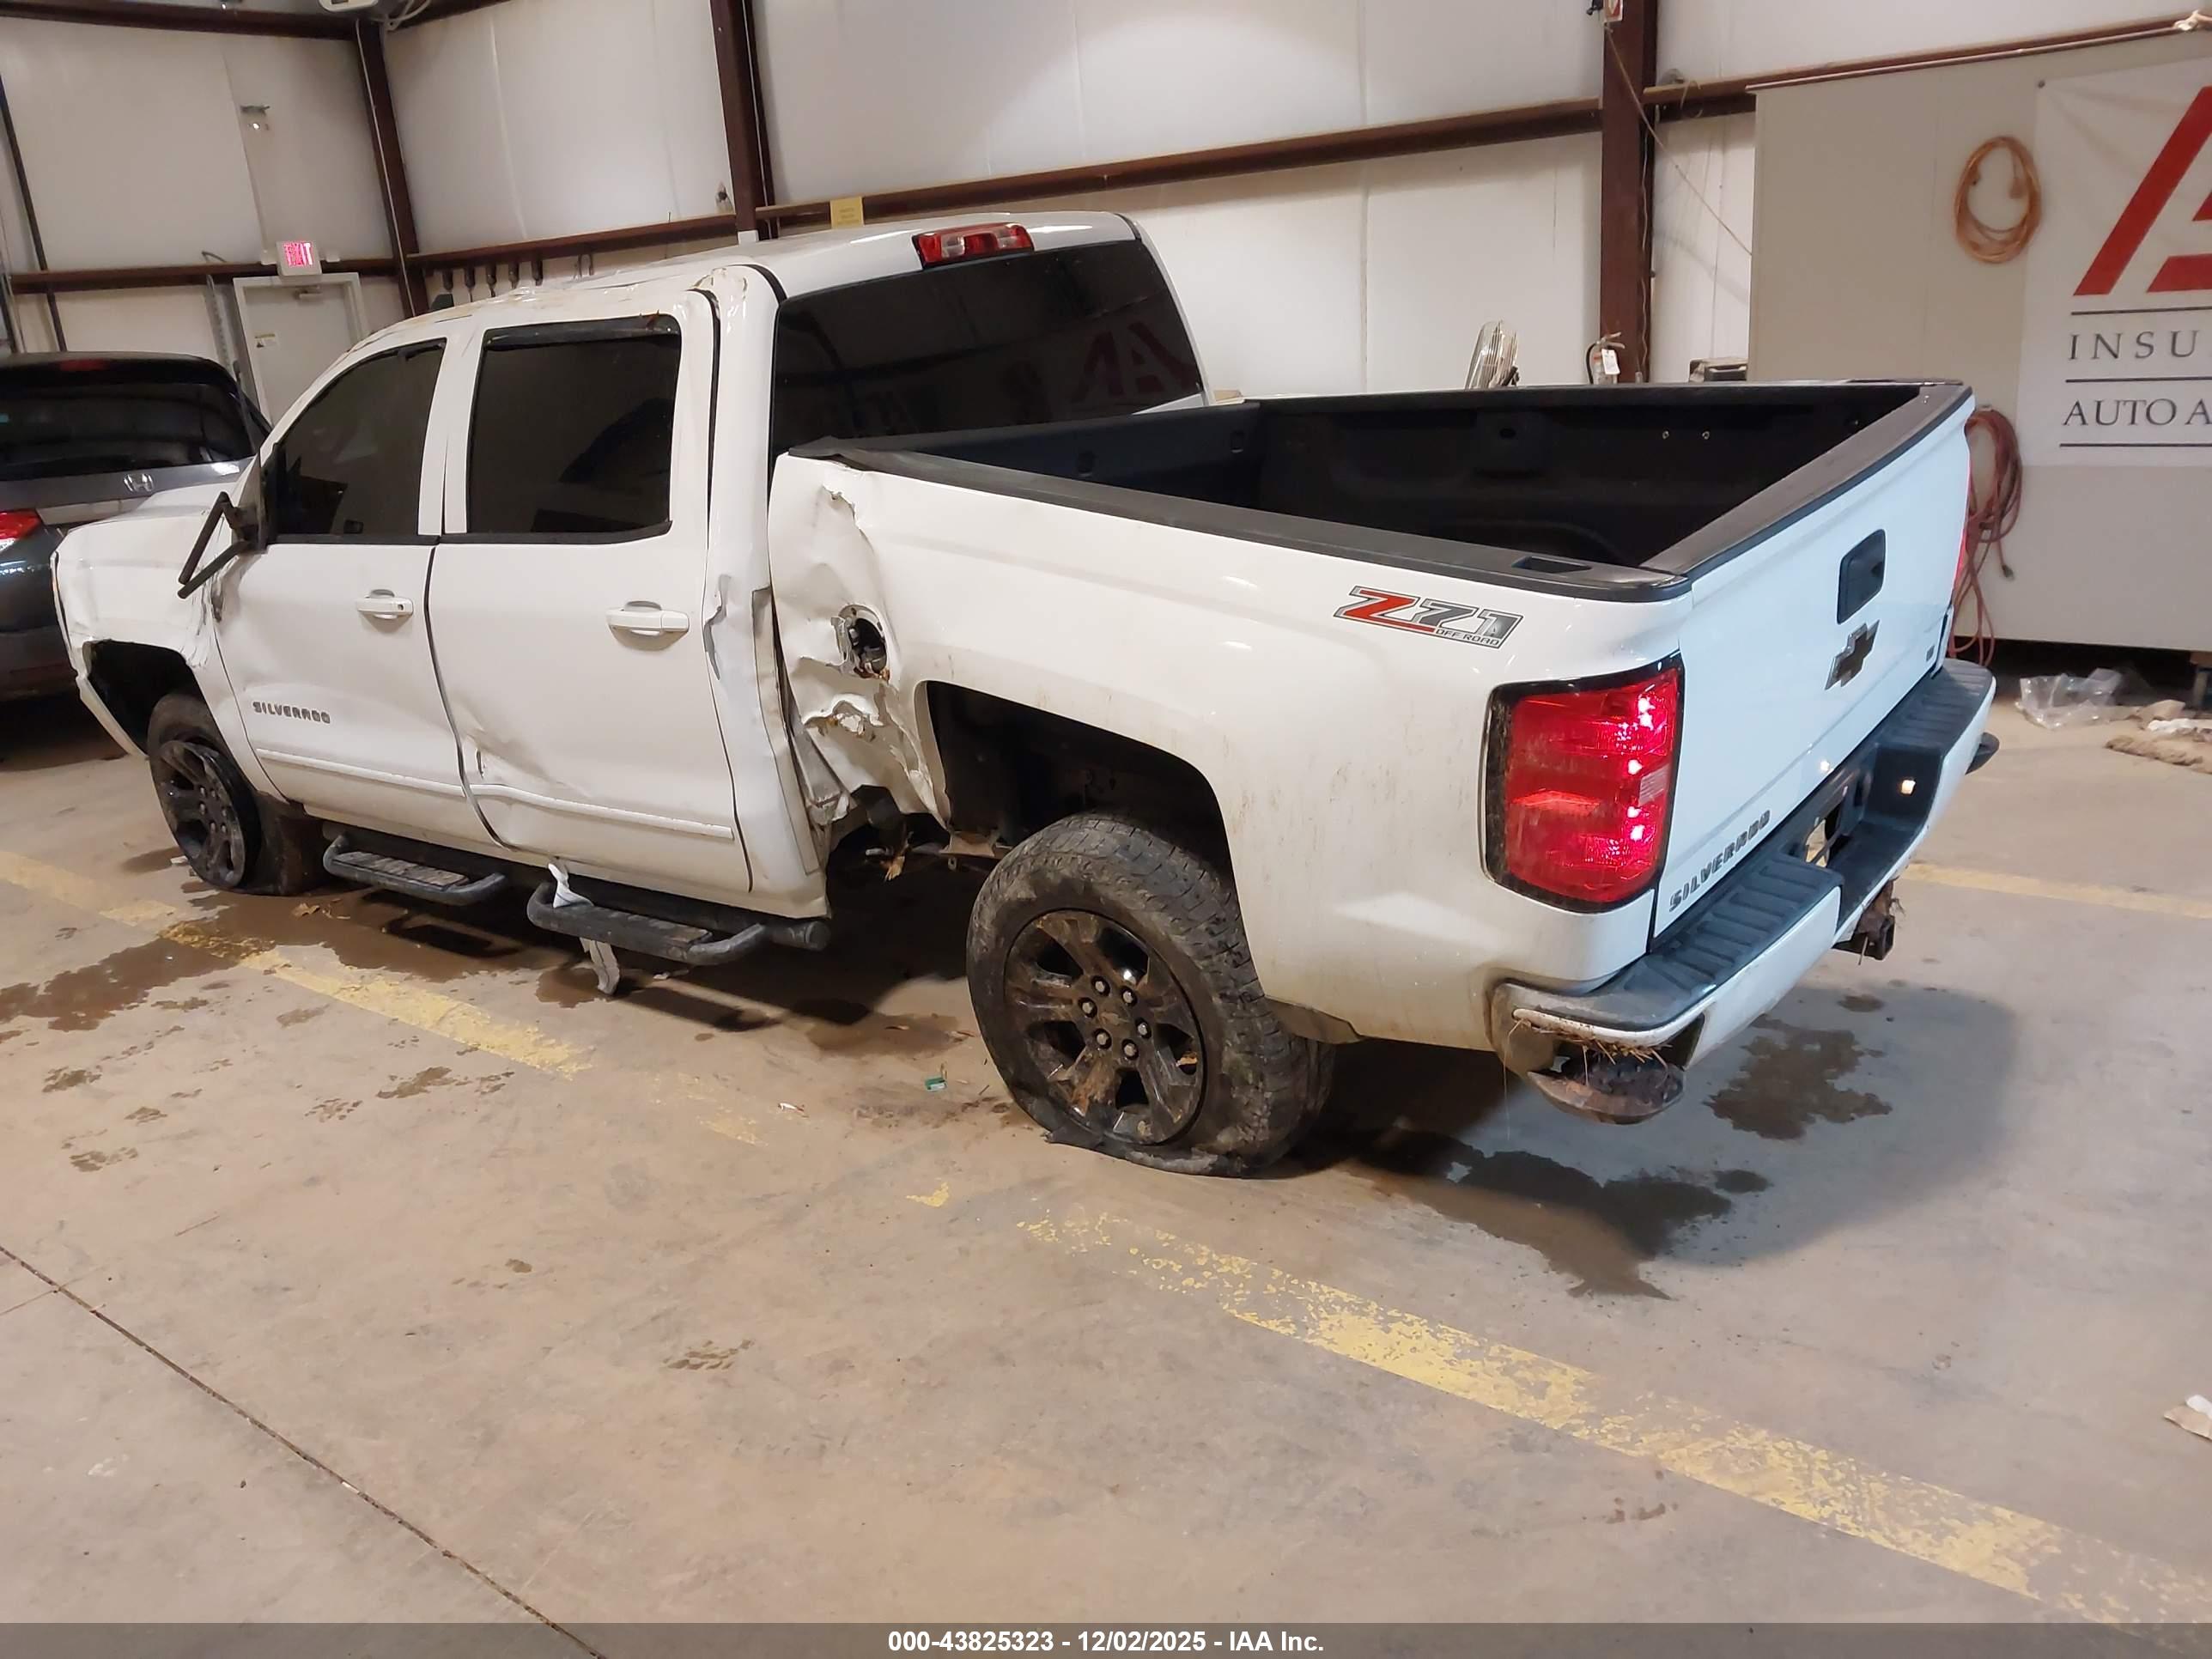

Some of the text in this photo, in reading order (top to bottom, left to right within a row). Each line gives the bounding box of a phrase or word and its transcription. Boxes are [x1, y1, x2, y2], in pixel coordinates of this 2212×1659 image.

[283, 242, 314, 267] EXIT
[2068, 330, 2212, 361] INSU
[2063, 398, 2177, 426] AUTO
[1333, 586, 1523, 649] Z71
[1436, 629, 1499, 646] OFF ROAD
[252, 701, 331, 724] SILVERADO
[1668, 810, 1771, 913] SILVERADO
